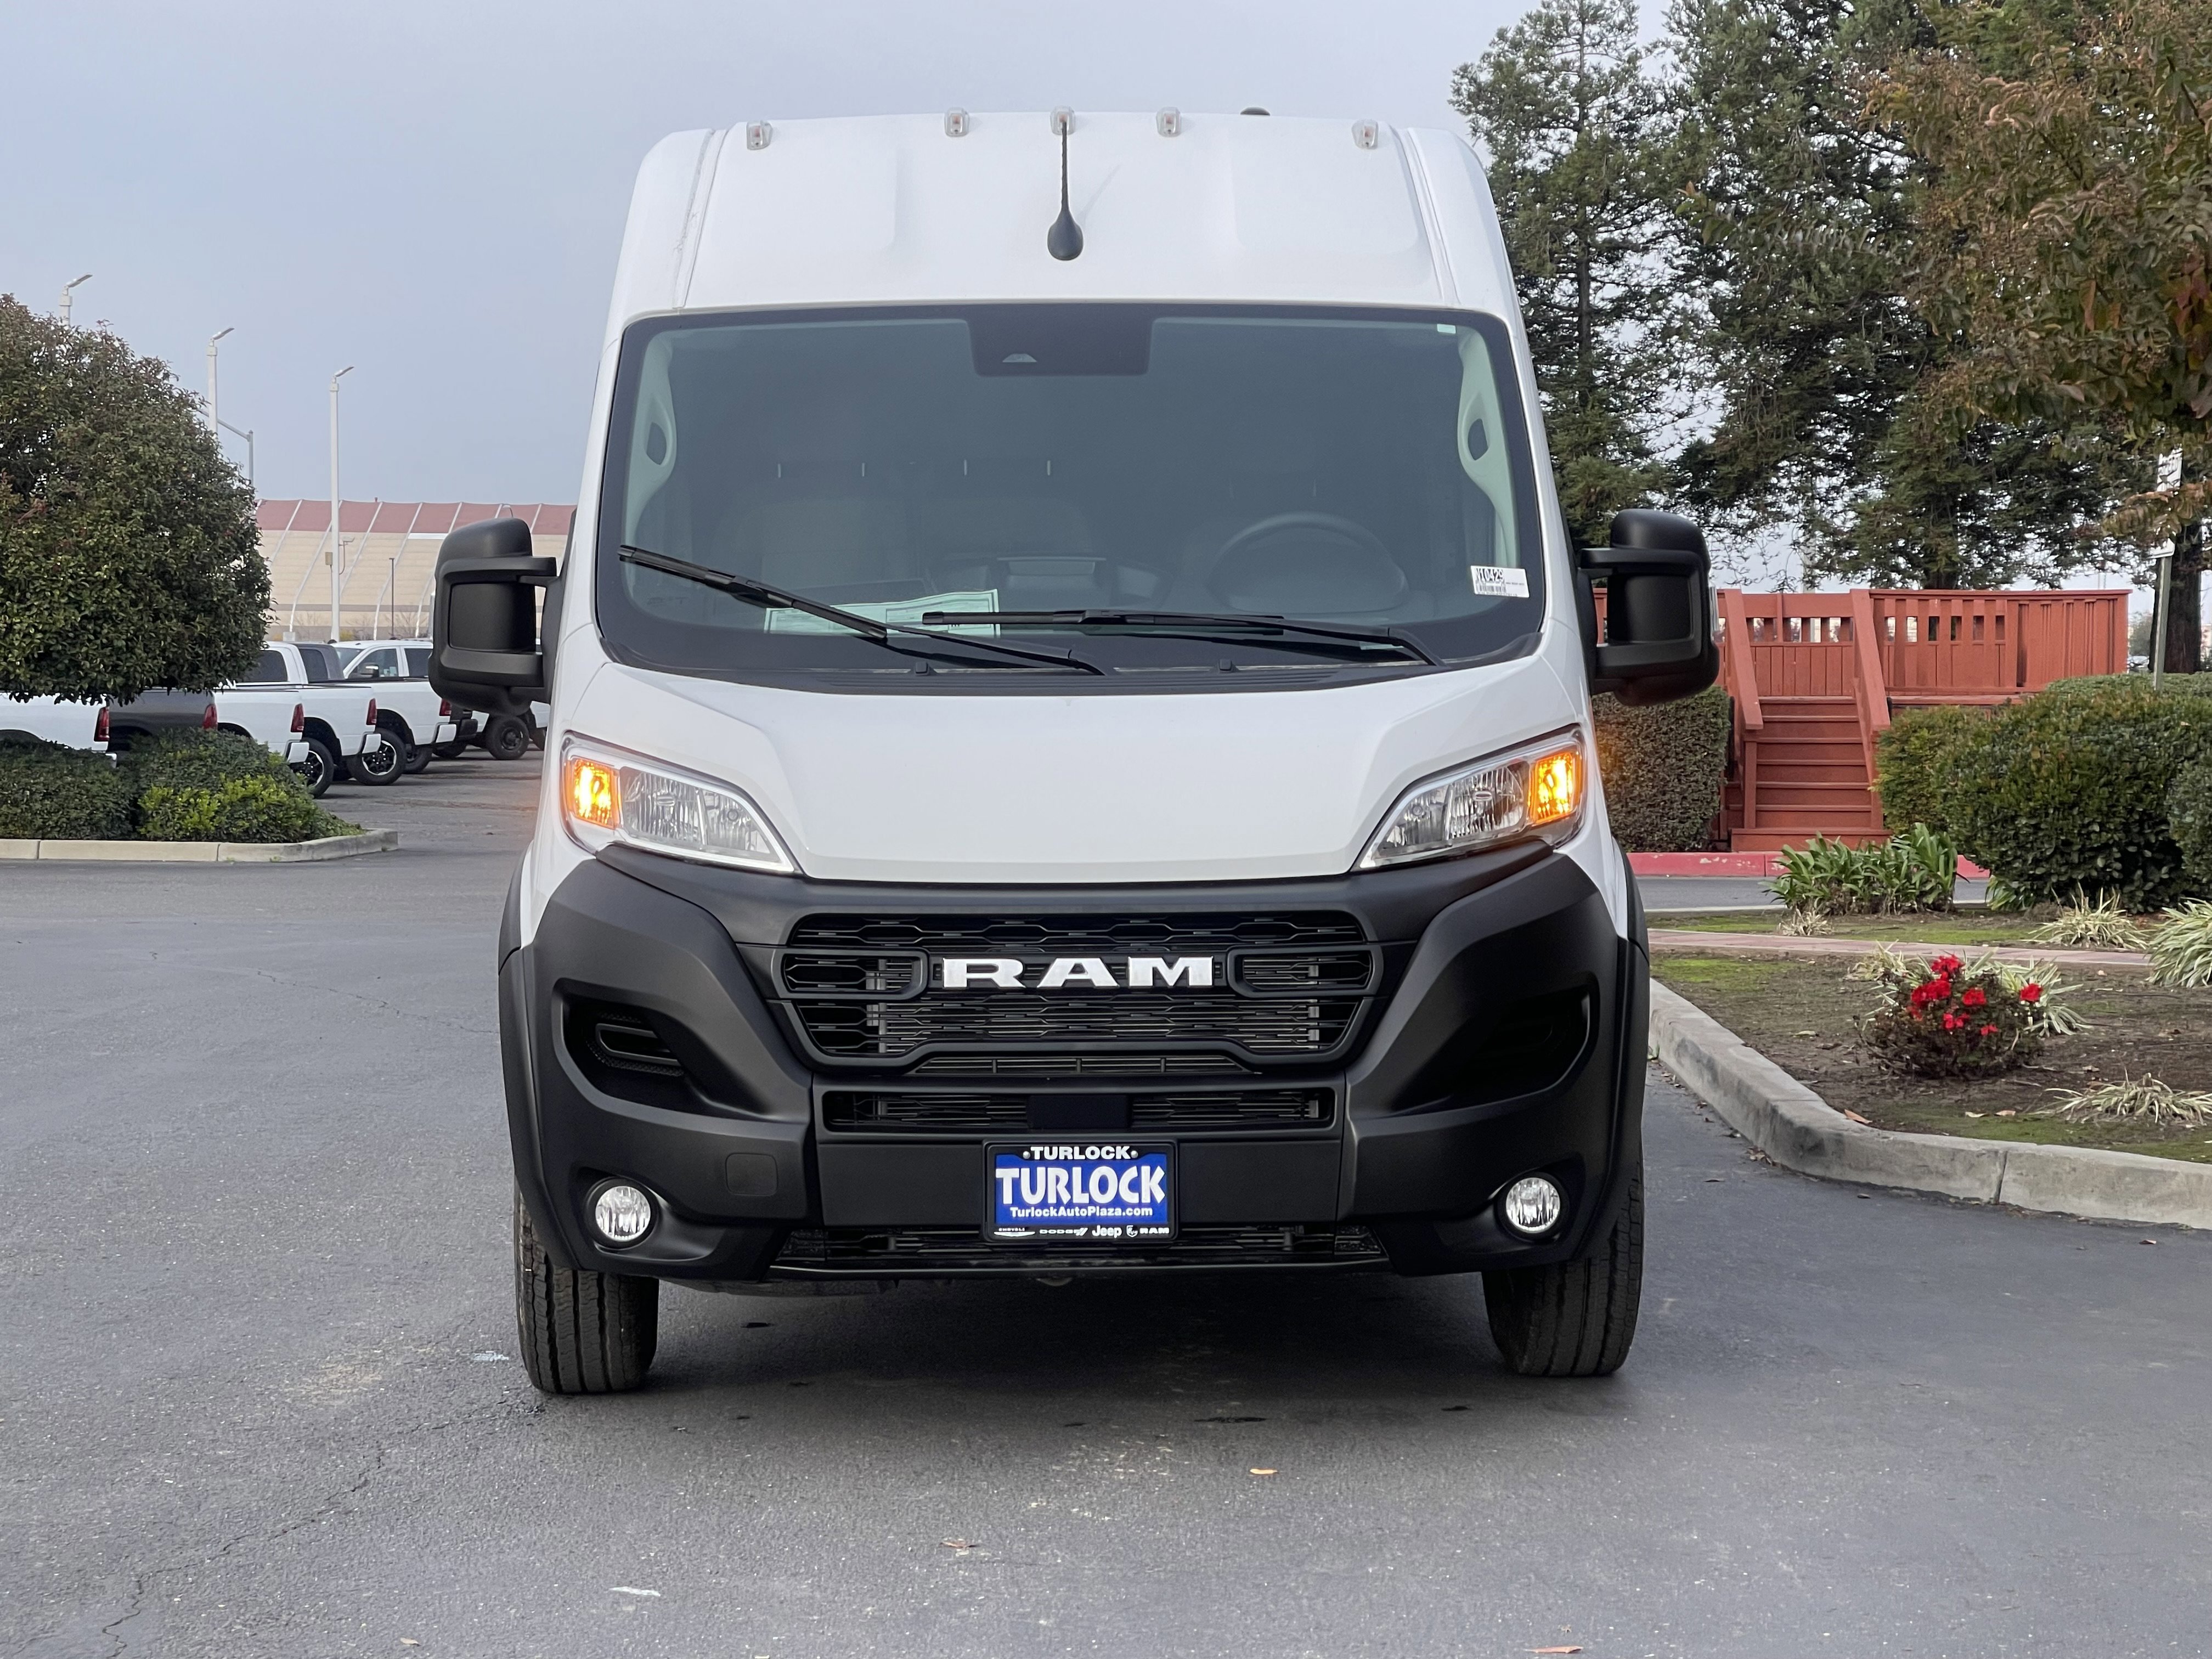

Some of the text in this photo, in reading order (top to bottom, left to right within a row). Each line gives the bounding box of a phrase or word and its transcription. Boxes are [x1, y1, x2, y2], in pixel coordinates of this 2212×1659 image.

[943, 956, 1214, 988] RAM
[1030, 1146, 1131, 1160] TURLOCK
[995, 1165, 1165, 1205] TURLOCK
[1010, 1206, 1153, 1217] TurlockAutoPlaza.com
[1092, 1225, 1122, 1238] Jeep
